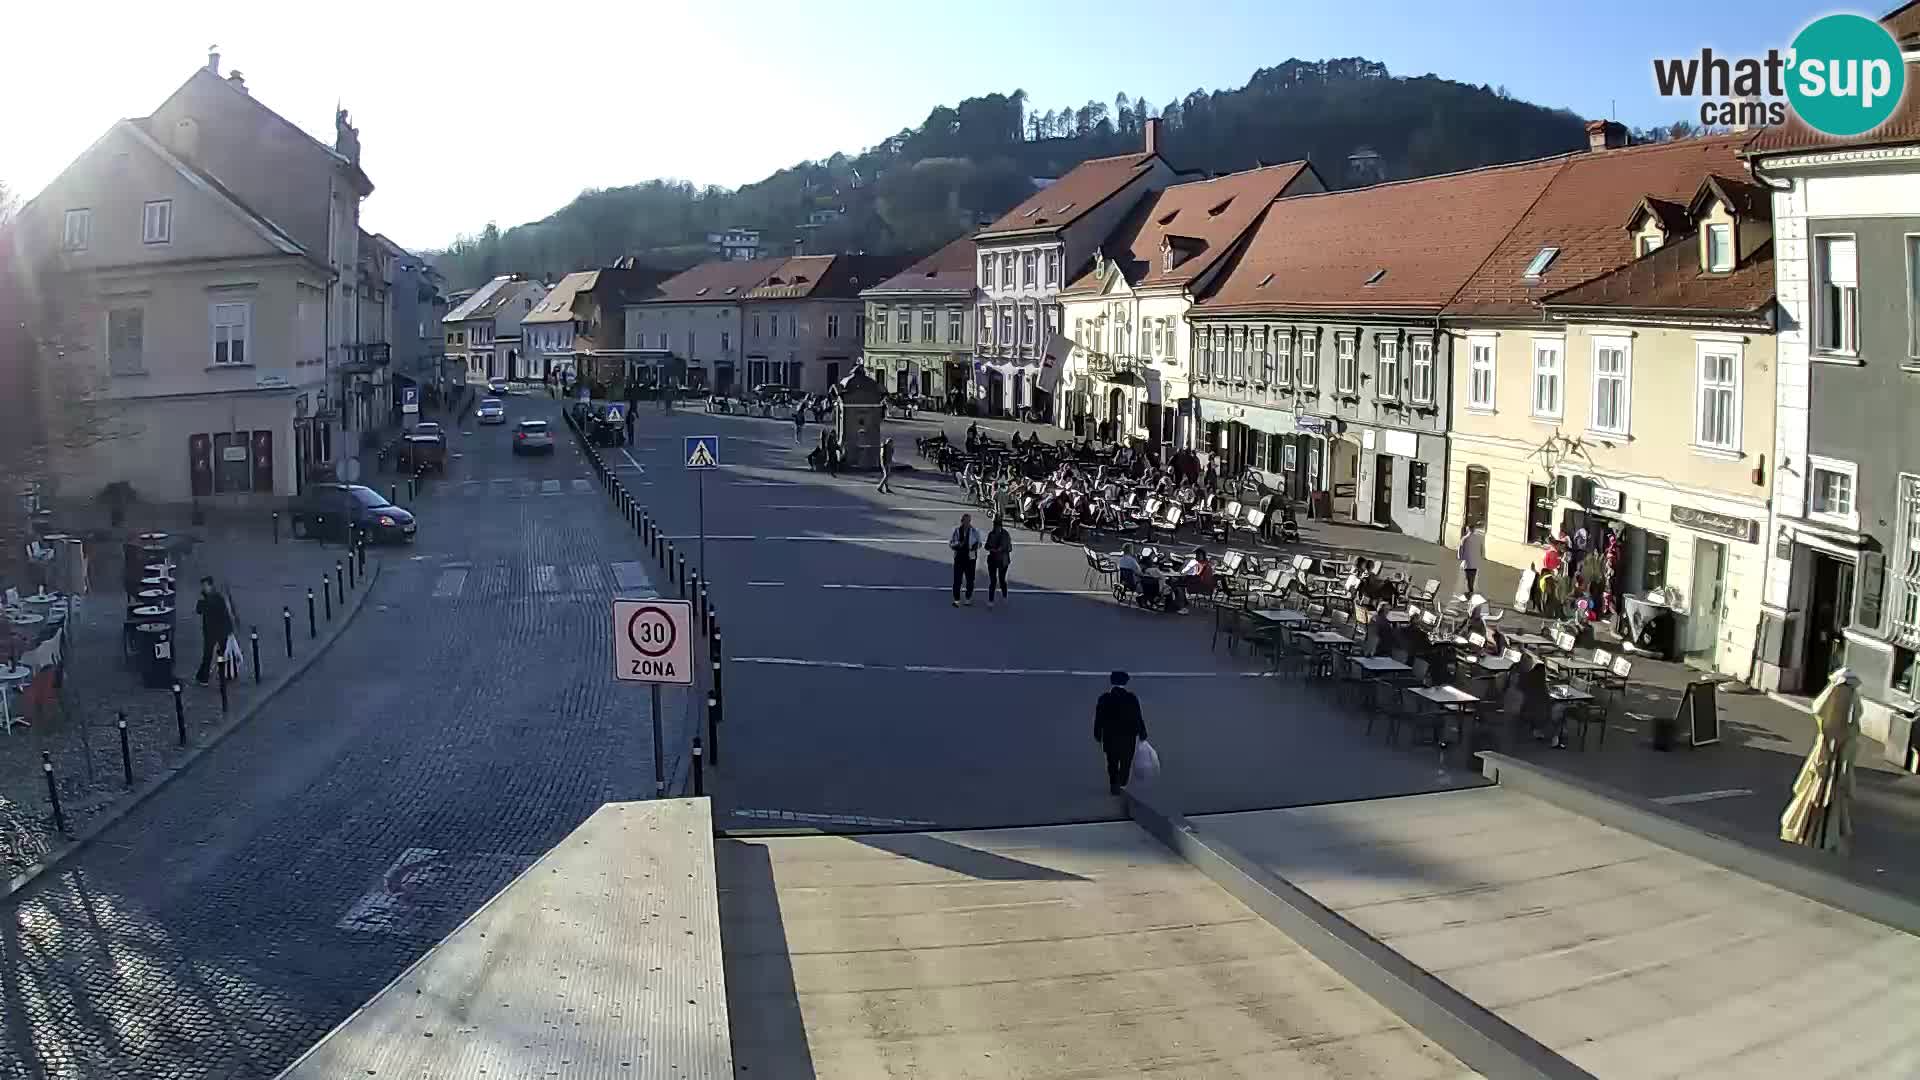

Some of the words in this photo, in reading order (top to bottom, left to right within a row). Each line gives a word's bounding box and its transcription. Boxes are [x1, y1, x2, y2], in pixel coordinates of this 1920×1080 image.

[407, 391, 414, 401] P
[641, 622, 665, 643] 30
[632, 660, 675, 676] ZONA
